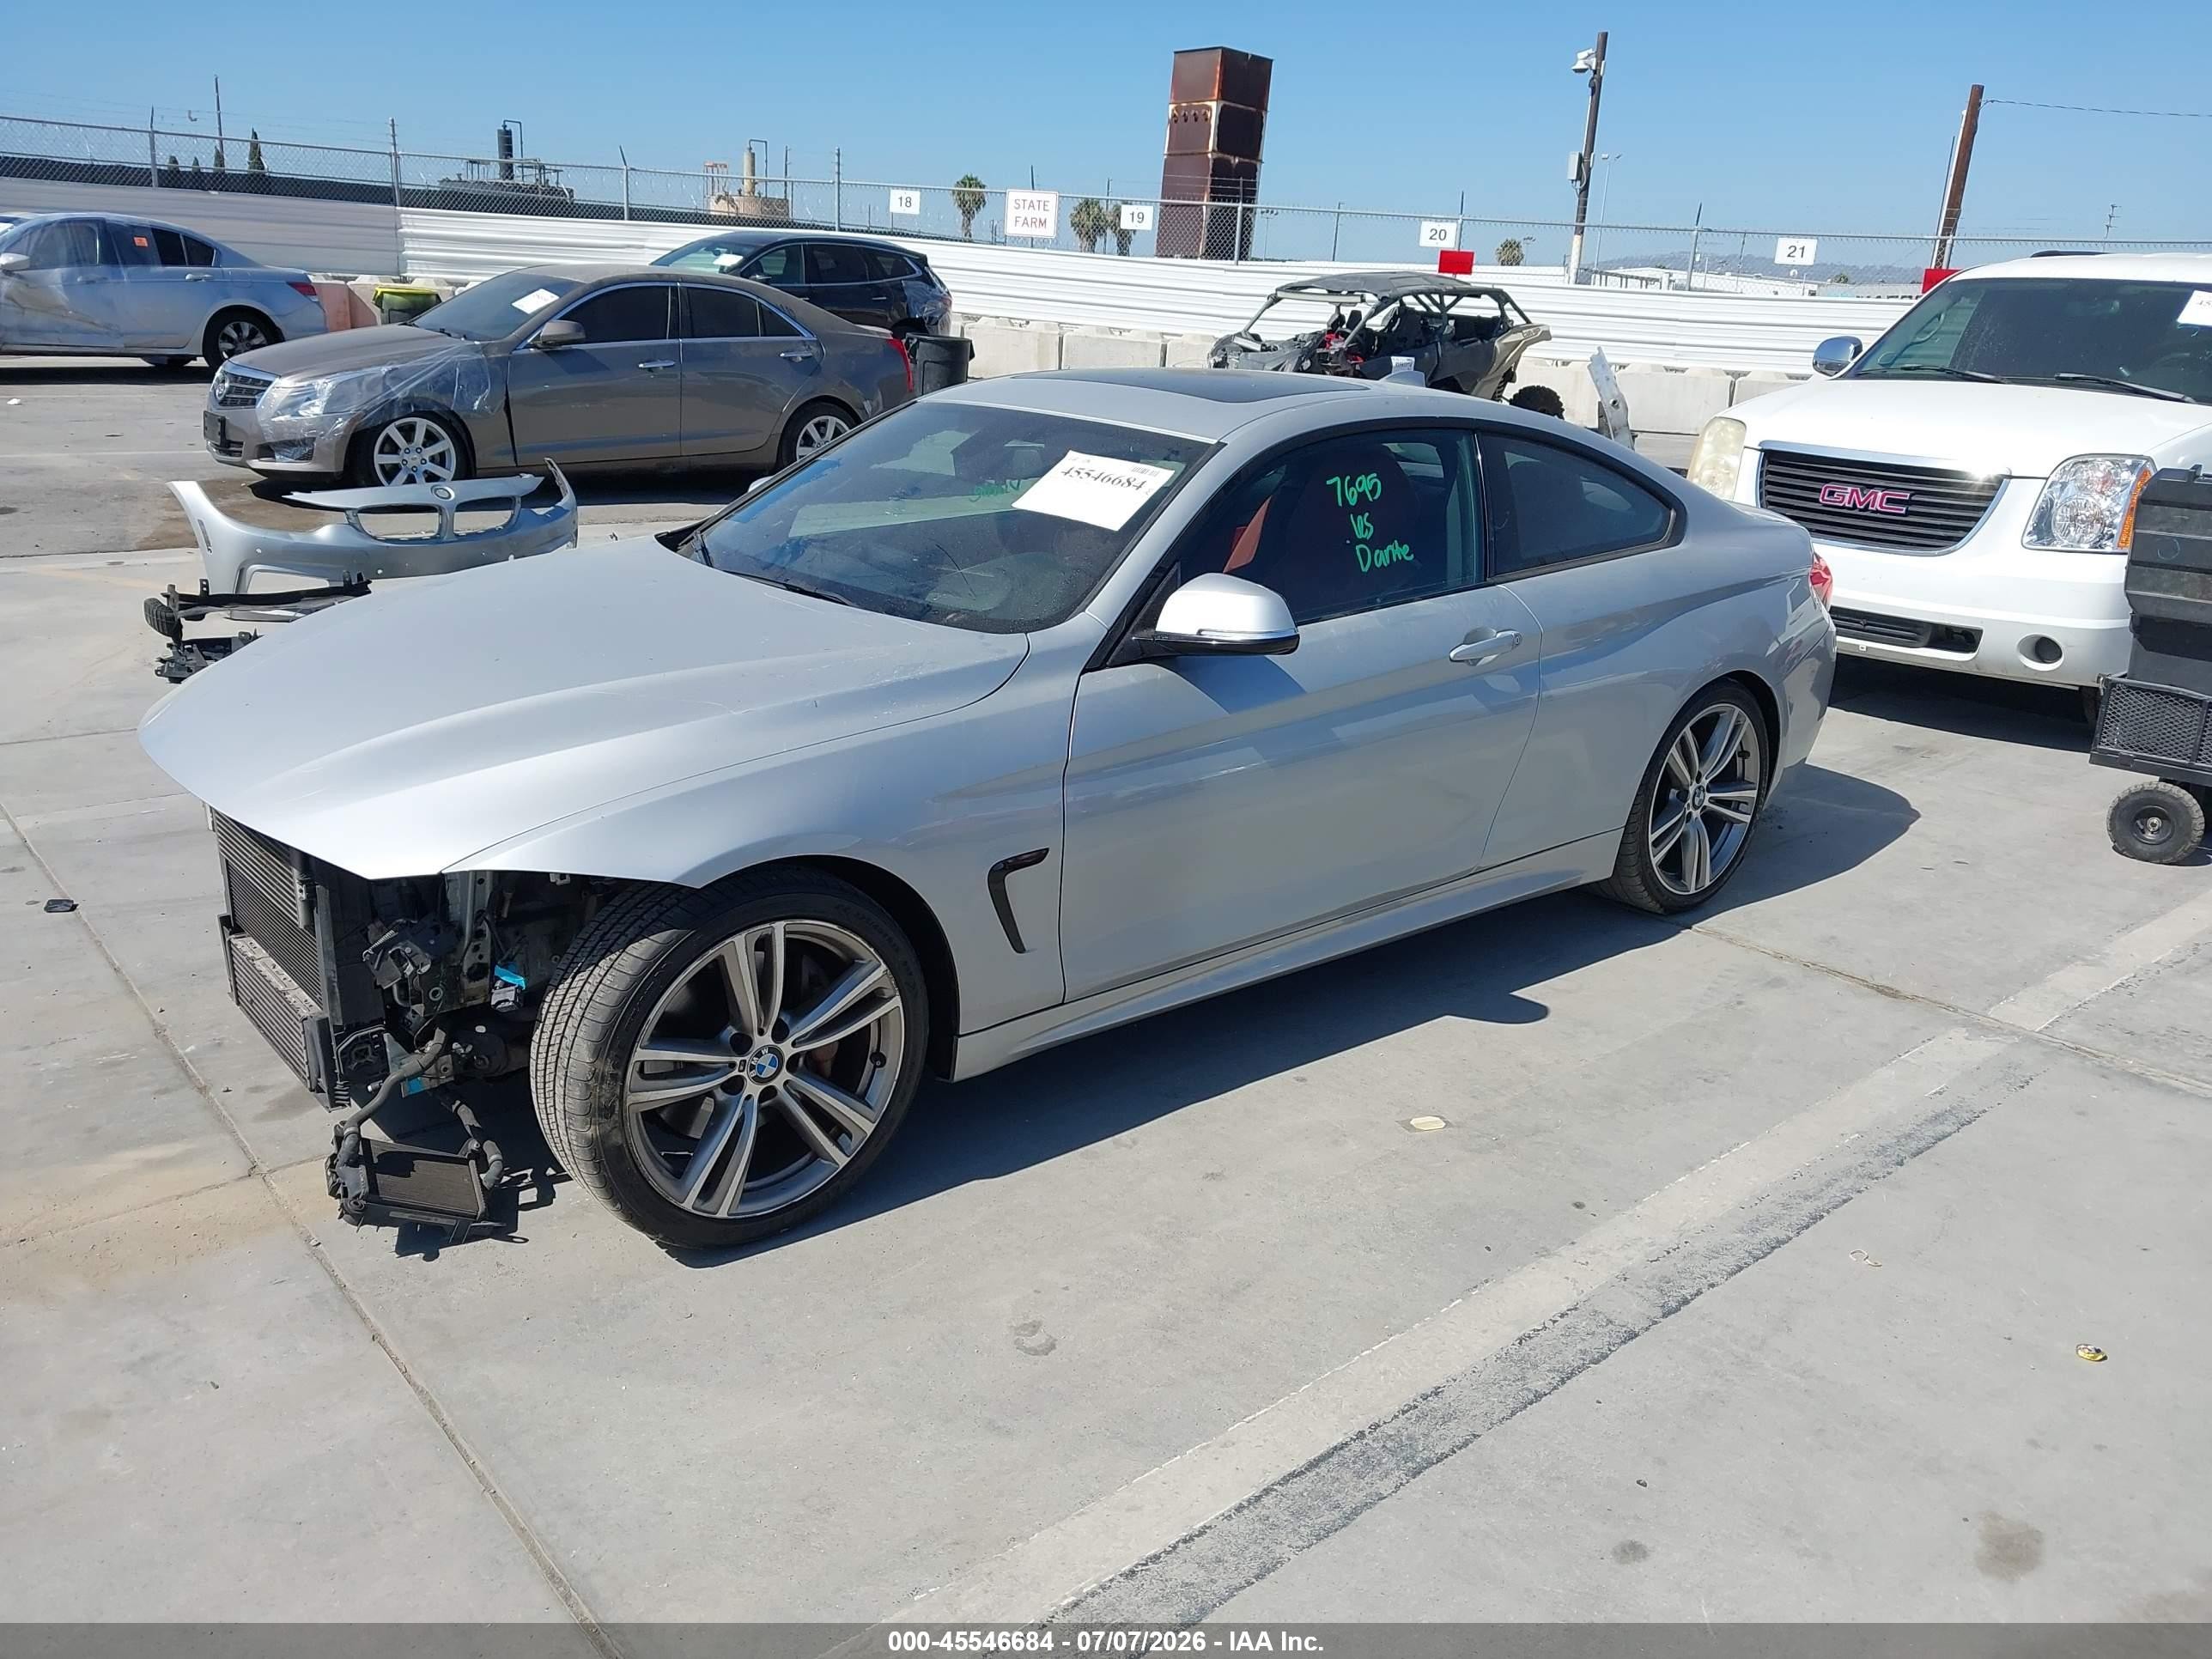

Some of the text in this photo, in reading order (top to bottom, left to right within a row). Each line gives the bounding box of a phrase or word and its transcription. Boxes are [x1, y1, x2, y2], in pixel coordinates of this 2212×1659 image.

[897, 196, 912, 209] 18
[1013, 198, 1050, 213] STATE
[1013, 216, 1048, 229] FARM
[1129, 210, 1145, 224] 19
[1428, 228, 1448, 242] 20
[1786, 245, 1806, 258] 21
[1060, 466, 1147, 490] 45546684
[1326, 472, 1382, 507] 7695
[1819, 484, 1911, 514] GMC
[750, 1047, 769, 1078] BMW
